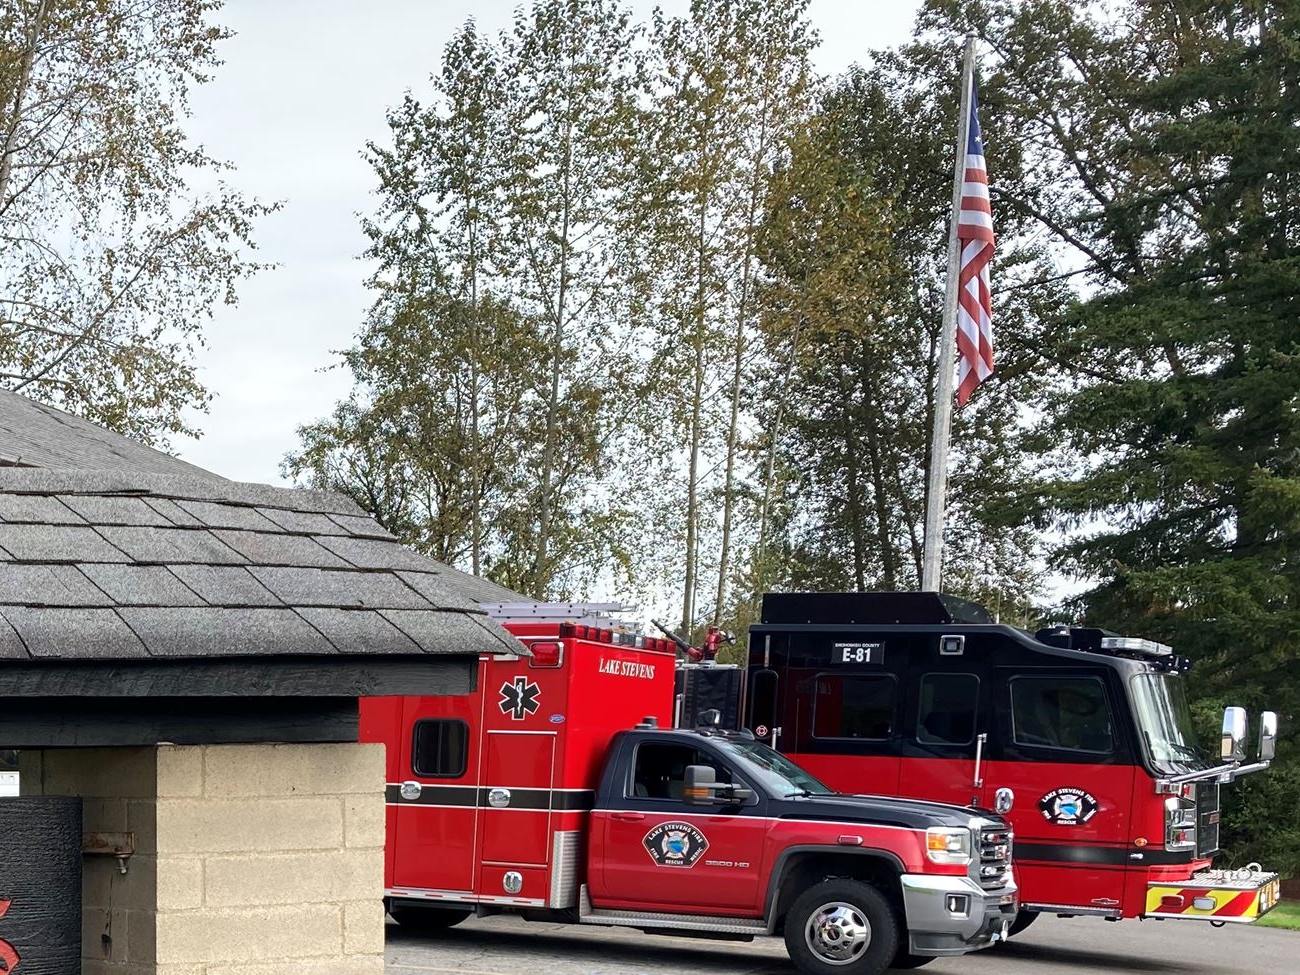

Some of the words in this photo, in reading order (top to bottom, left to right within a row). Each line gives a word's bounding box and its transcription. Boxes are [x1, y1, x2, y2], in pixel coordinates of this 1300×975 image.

[842, 647, 871, 662] E-81
[599, 658, 621, 675] LAKE
[620, 661, 655, 680] STEVENS
[1041, 791, 1057, 803] LAKE
[1057, 788, 1085, 796] STEVENS
[648, 827, 663, 841] LAKE
[664, 824, 692, 833] STEVENS
[691, 830, 704, 844] FIRE
[649, 847, 660, 859] FIRE
